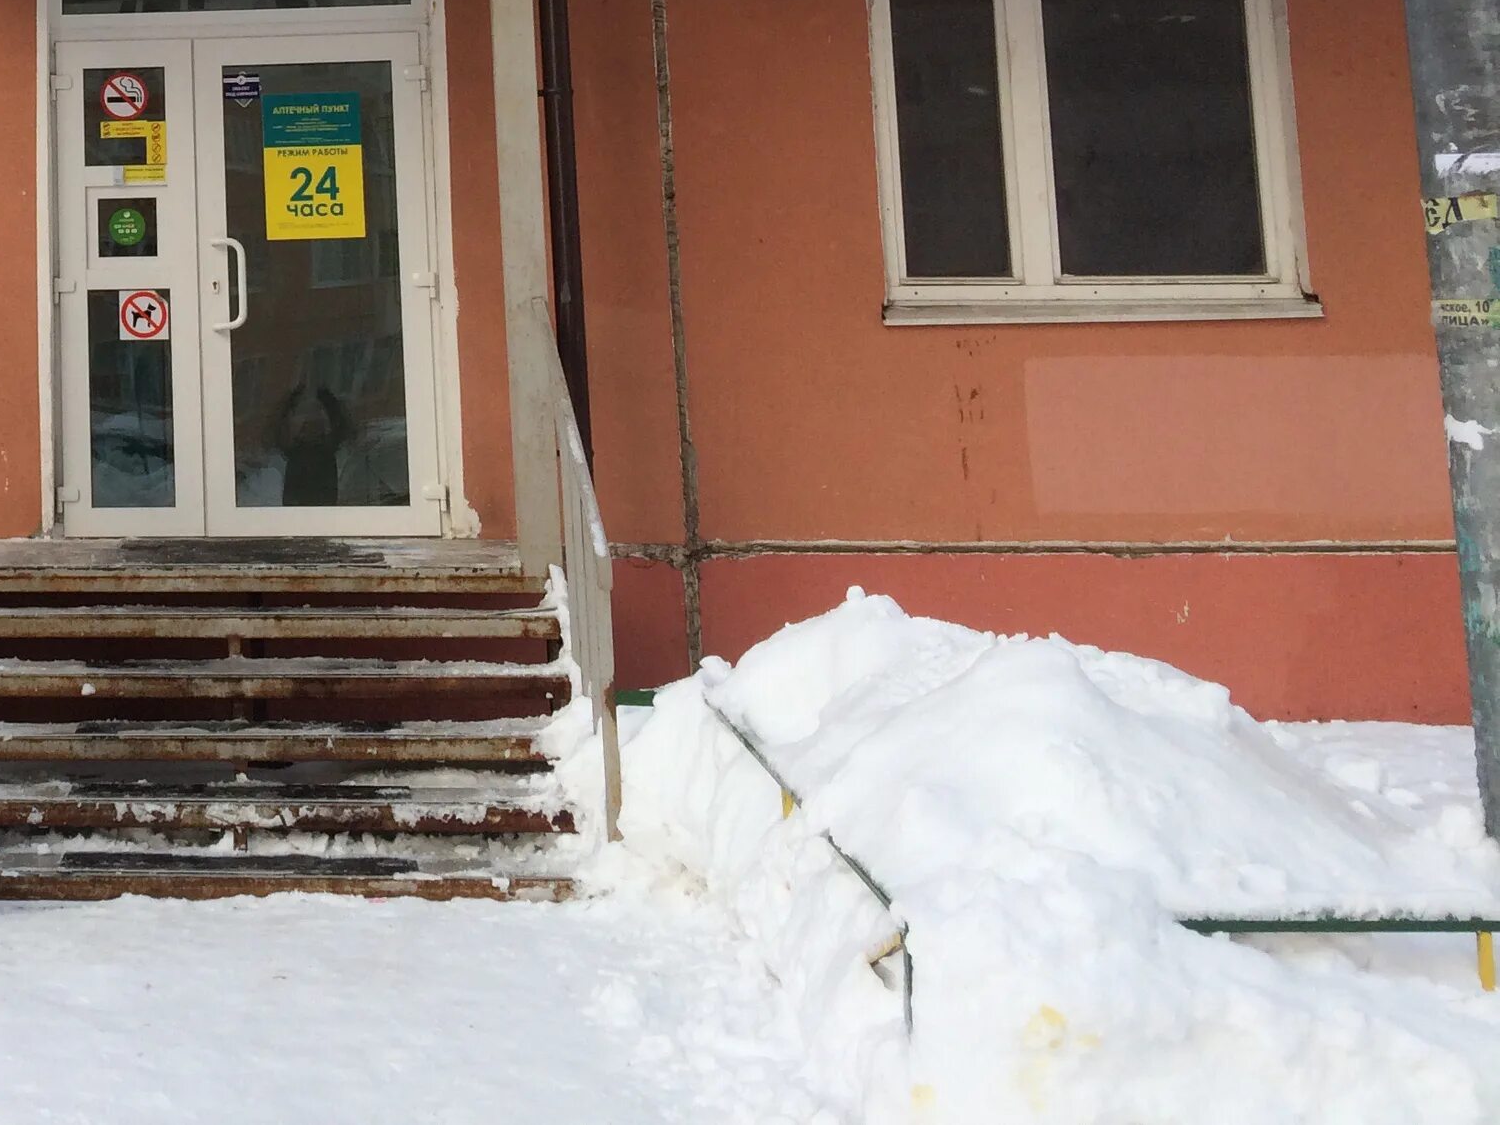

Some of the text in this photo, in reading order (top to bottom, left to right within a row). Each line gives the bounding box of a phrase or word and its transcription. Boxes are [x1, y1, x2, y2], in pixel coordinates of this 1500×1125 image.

[272, 103, 350, 115] АПТЕЧНЫЙ ПУНКТ
[277, 147, 349, 158] РЕЖИМ РАБОТЫ
[290, 166, 340, 202] 24
[286, 202, 344, 217] часа
[1476, 300, 1490, 313] 10
